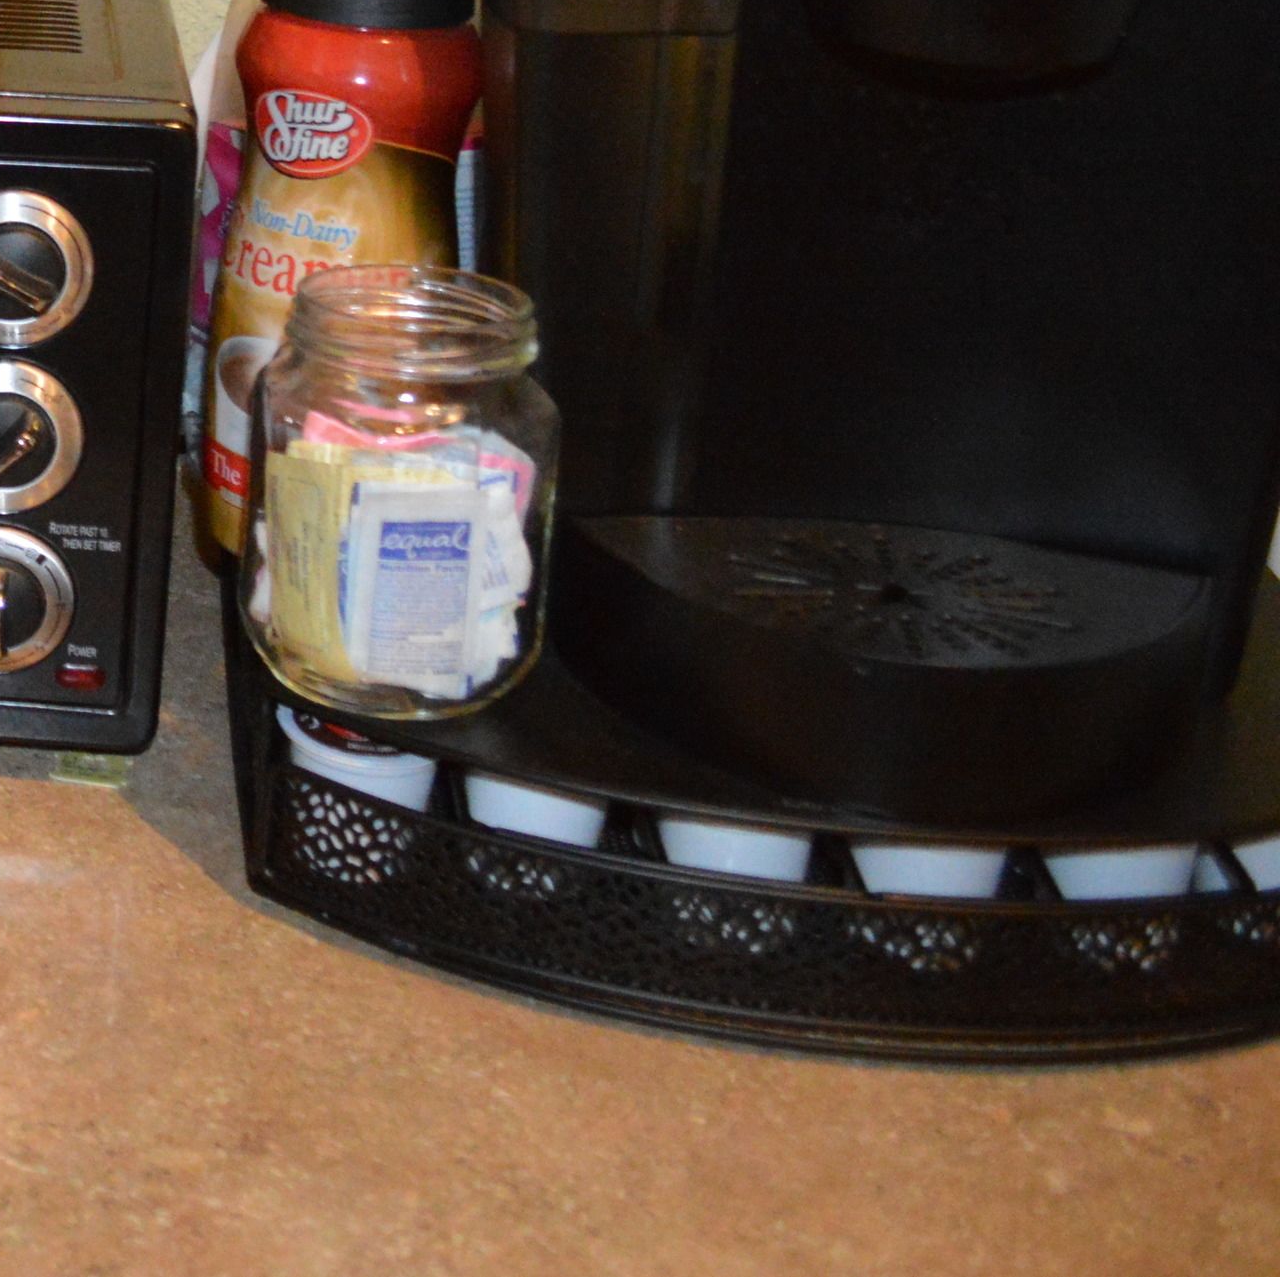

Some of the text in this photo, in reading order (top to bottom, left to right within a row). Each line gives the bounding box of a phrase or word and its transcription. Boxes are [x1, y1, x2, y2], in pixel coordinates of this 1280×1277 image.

[252, 197, 358, 251] Non-Dairy
[210, 448, 242, 487] The
[383, 524, 470, 560] equal
[67, 643, 97, 658] POWER
